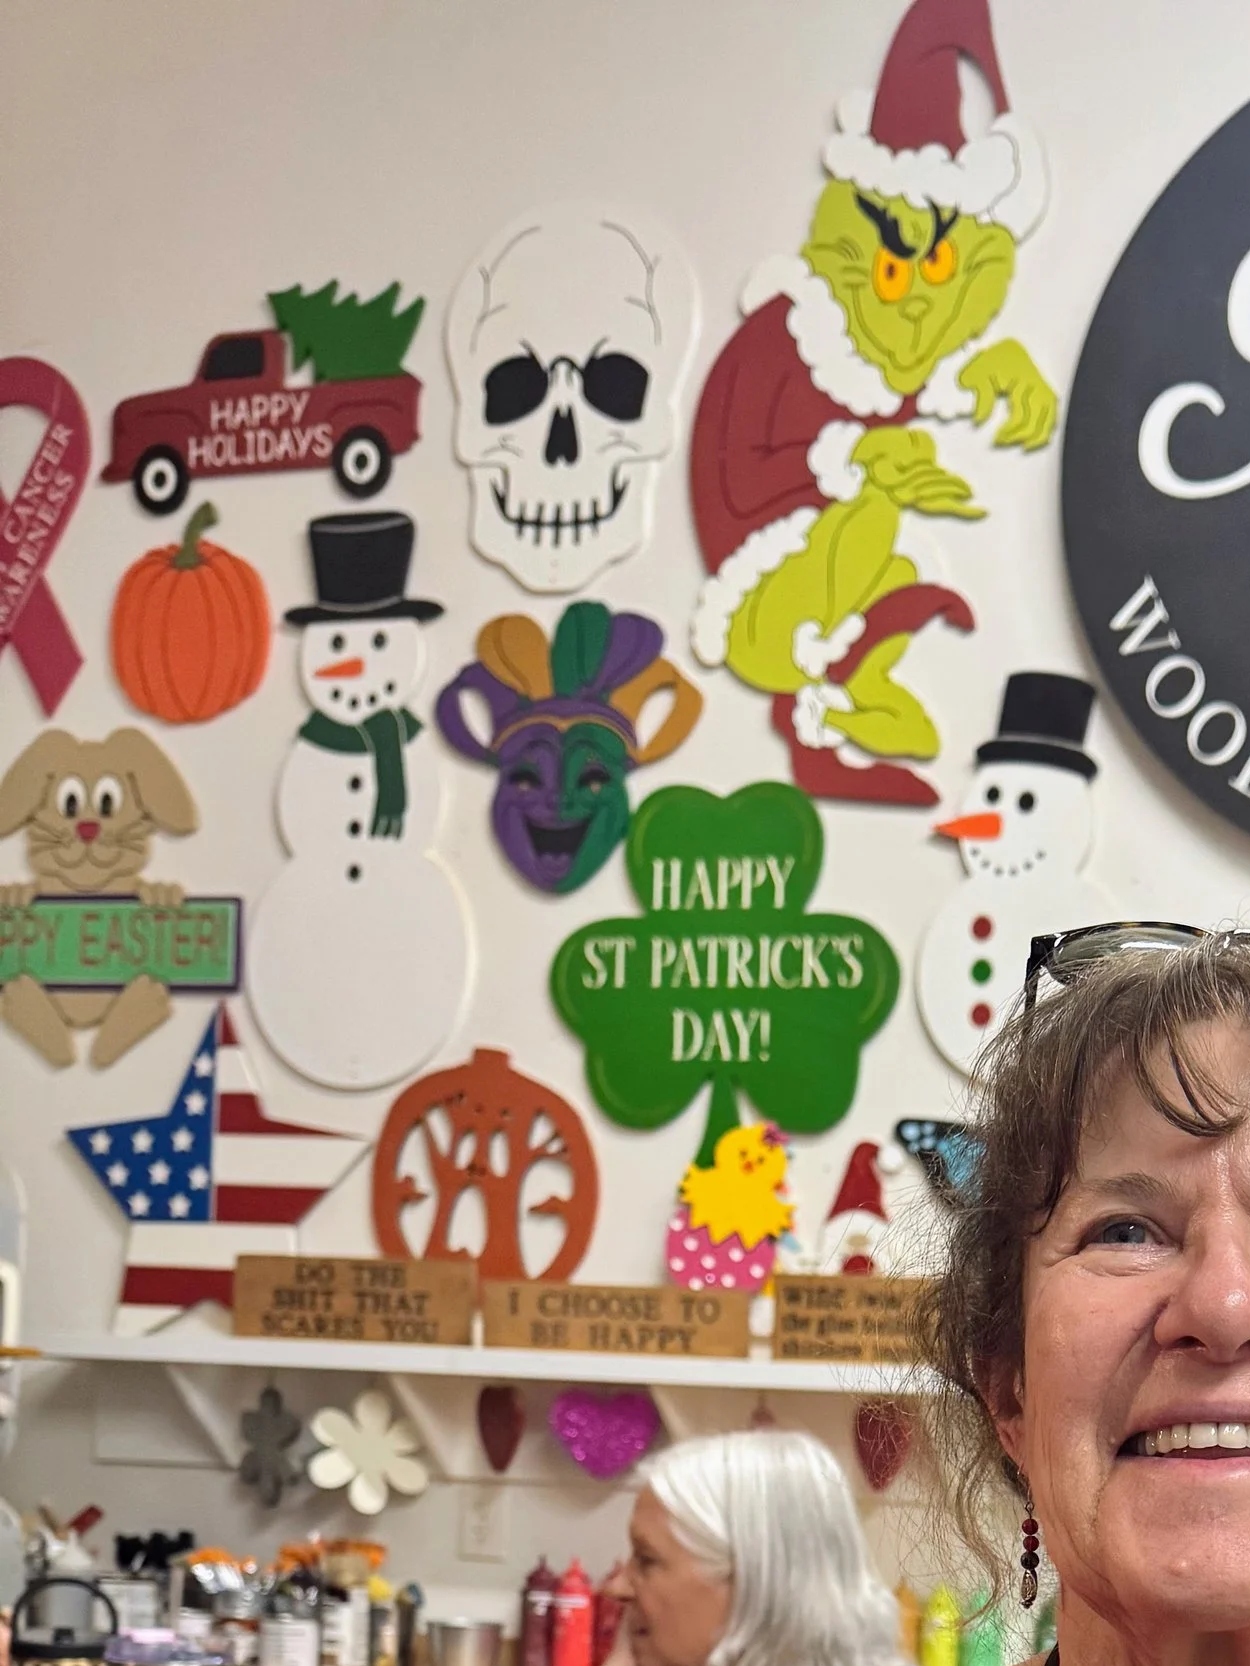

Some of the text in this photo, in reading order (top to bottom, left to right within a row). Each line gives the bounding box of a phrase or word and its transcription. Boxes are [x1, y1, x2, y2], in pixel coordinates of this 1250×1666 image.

[209, 390, 311, 432] HAPPY
[187, 422, 333, 470] HOLIDAYS
[3, 422, 74, 544] CANCER
[651, 854, 796, 911] HAPPY
[0, 908, 62, 967] PPY
[581, 933, 864, 990] ST PATRICK'S
[671, 1007, 772, 1063] DAY!
[295, 1262, 335, 1285] DO
[353, 1290, 430, 1317] THAT
[508, 1287, 723, 1326] I CHOOSE TO
[382, 1318, 440, 1343] YOU
[531, 1320, 698, 1351] BE HAPPY
